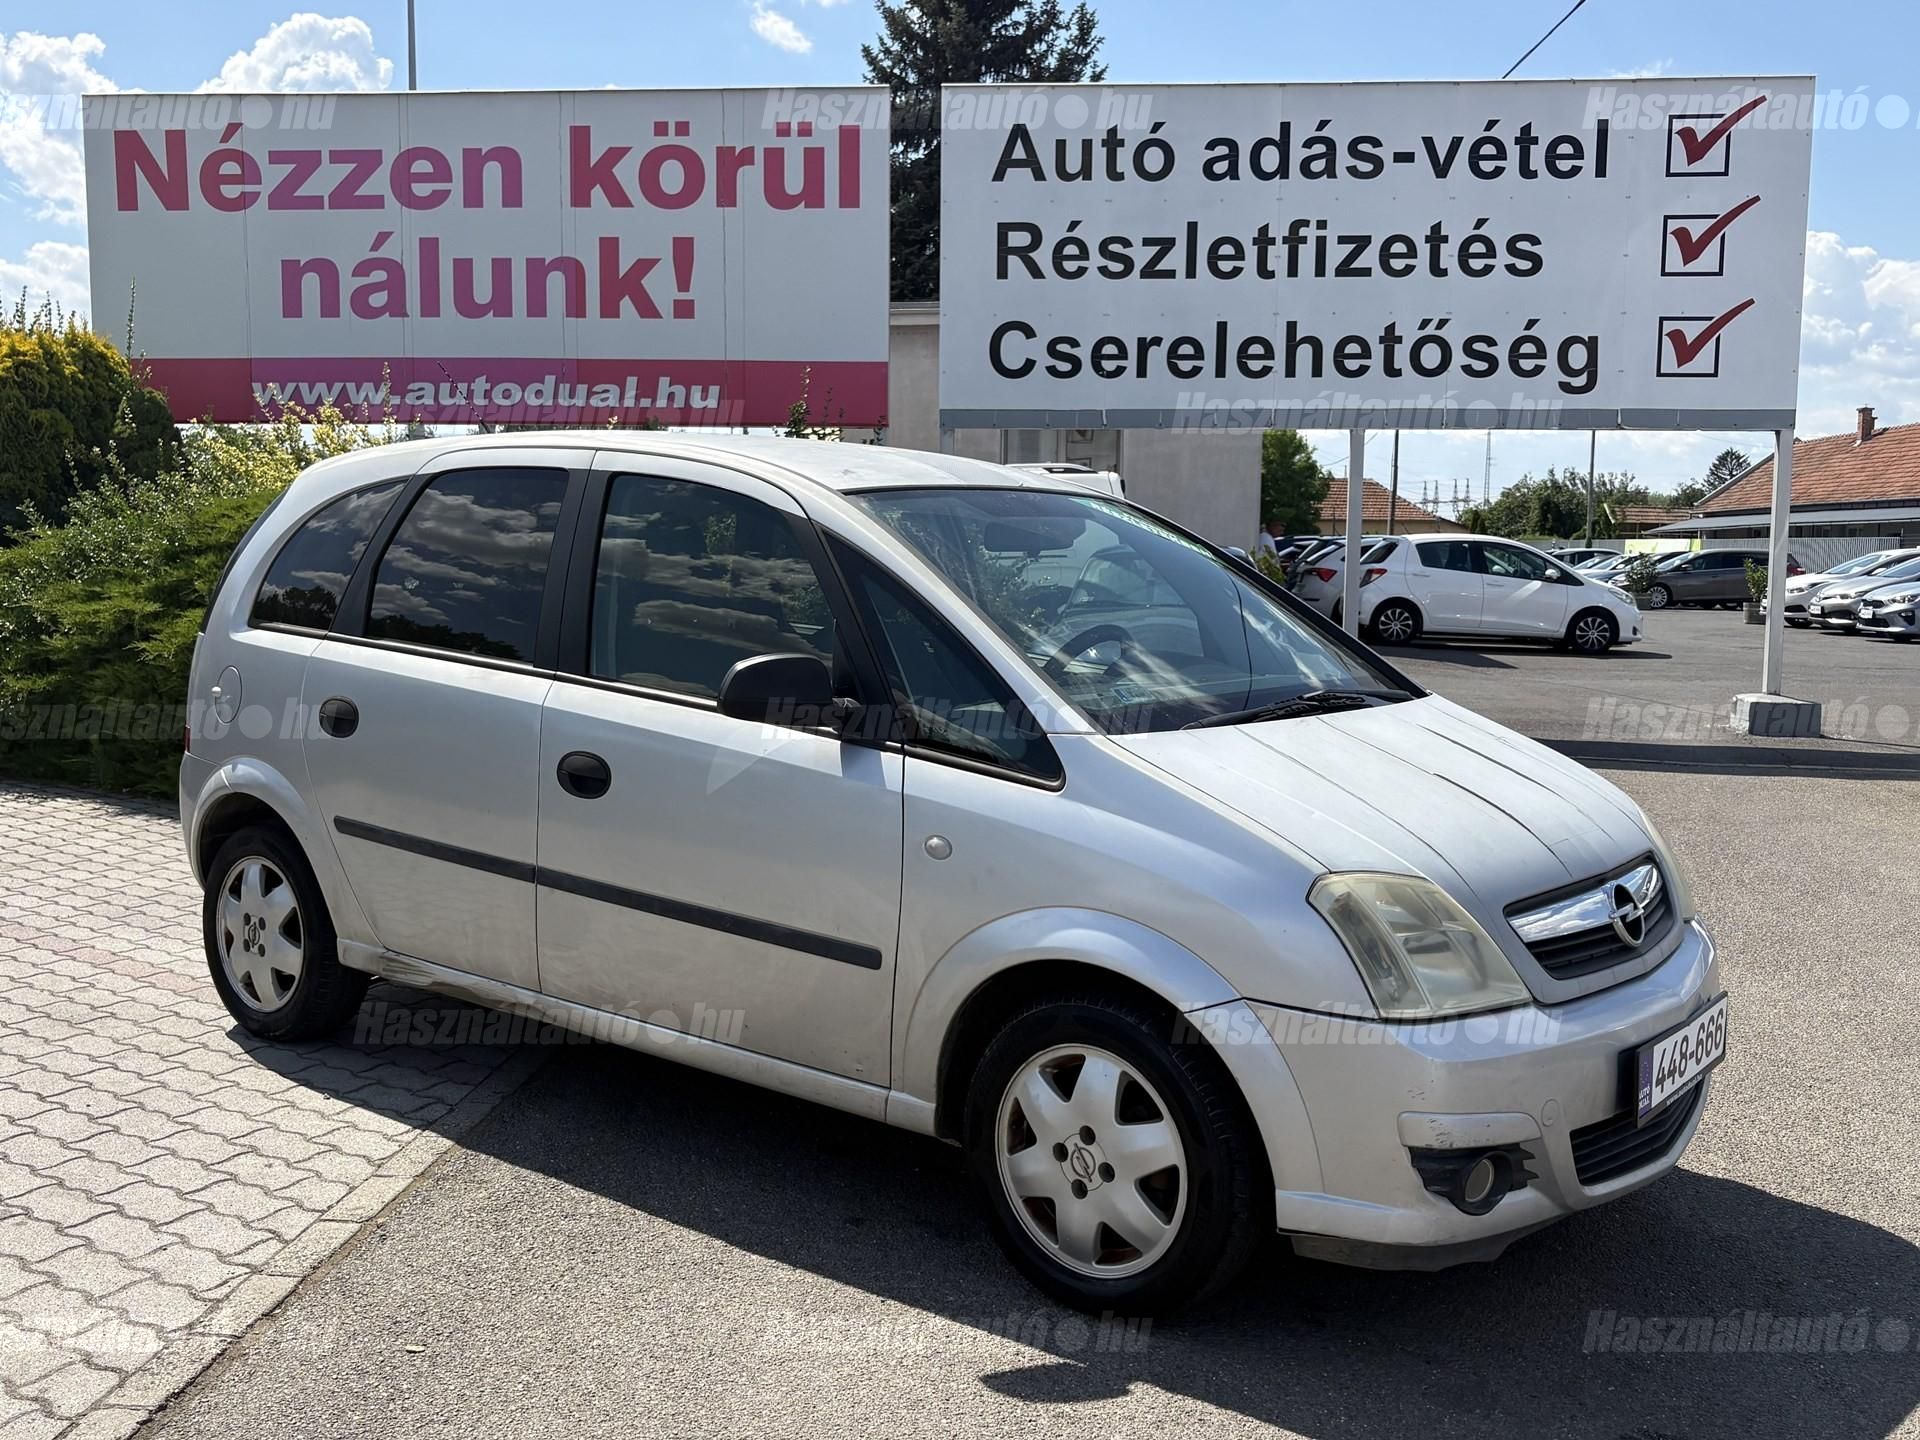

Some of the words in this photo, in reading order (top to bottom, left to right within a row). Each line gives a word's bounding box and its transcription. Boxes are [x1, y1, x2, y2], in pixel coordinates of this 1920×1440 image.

[113, 125, 521, 211] Nézzen
[571, 122, 861, 209] körül
[991, 121, 1175, 183] Autó
[1202, 118, 1609, 182] adás-vétel
[281, 232, 696, 319] nálunk!
[996, 217, 1544, 281] Részletfizetés
[252, 375, 720, 409] www.autodual.hu
[989, 316, 1600, 395] Cserelehetőség
[1655, 1007, 1724, 1093] 448-666
